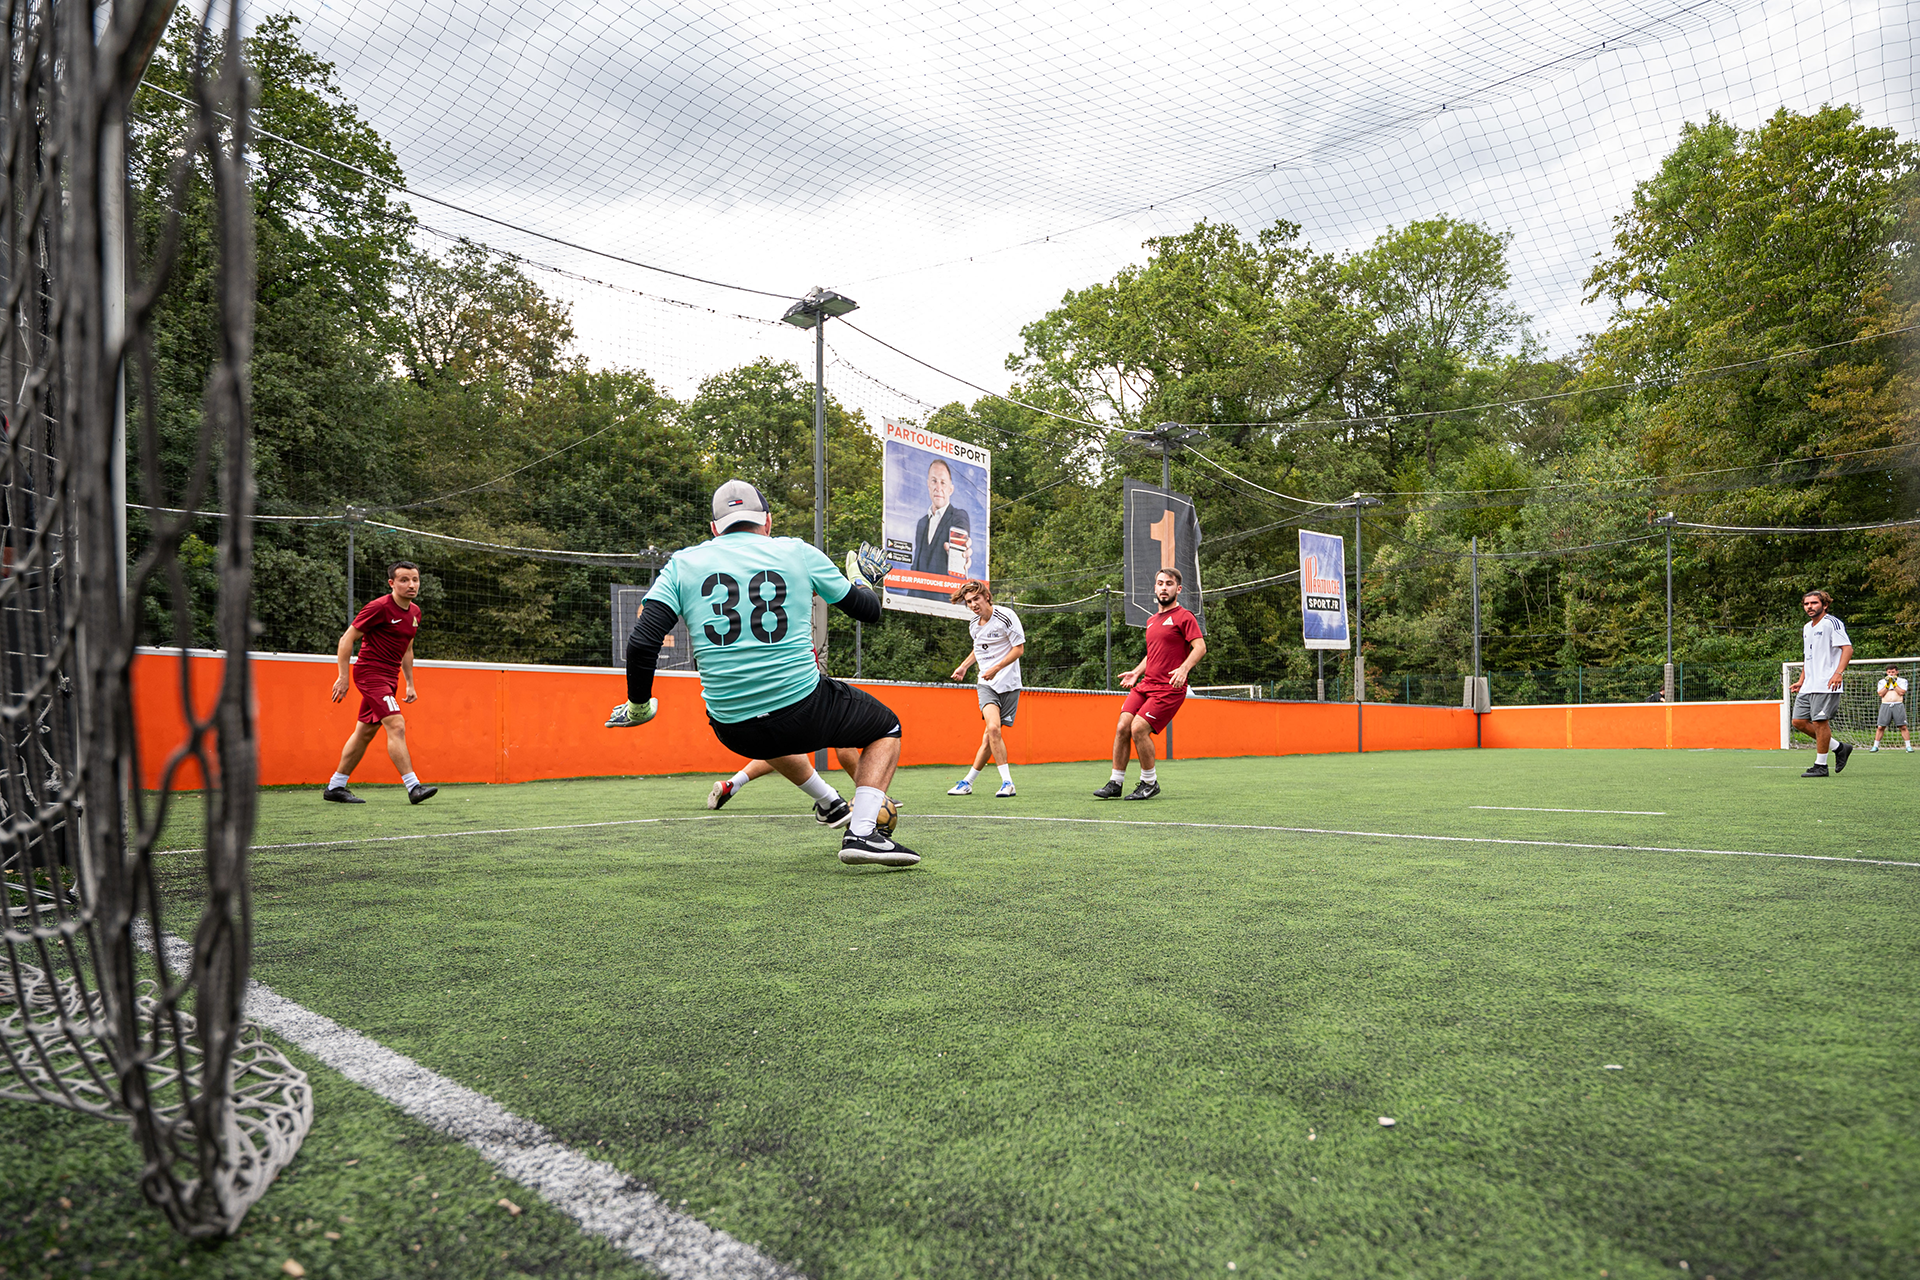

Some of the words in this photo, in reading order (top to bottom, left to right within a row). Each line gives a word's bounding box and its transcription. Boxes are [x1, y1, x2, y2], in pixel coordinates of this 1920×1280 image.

[887, 423, 986, 464] PARTOUCHESPORT
[1150, 509, 1176, 568] 1
[913, 577, 943, 587] PARTOUCHE
[944, 581, 961, 589] SPORT
[1308, 598, 1339, 609] SPORT.FR
[701, 570, 788, 646] 38
